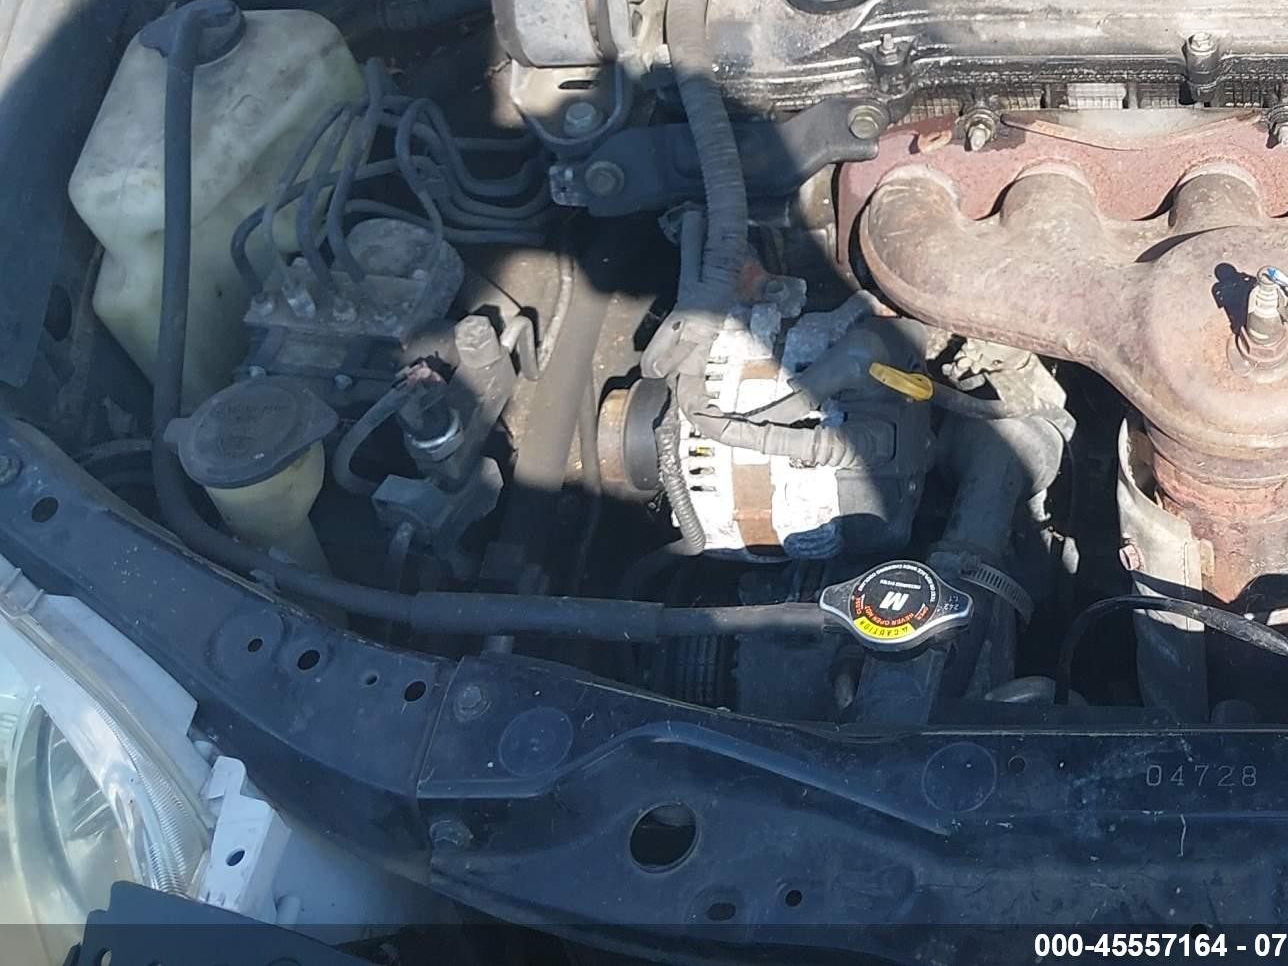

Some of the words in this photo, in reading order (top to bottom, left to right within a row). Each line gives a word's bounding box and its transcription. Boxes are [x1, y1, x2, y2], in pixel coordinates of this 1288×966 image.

[873, 615, 890, 625] OPEN
[891, 612, 914, 626] NEVER
[860, 621, 898, 636] CAUTION
[1146, 764, 1257, 787] 04728
